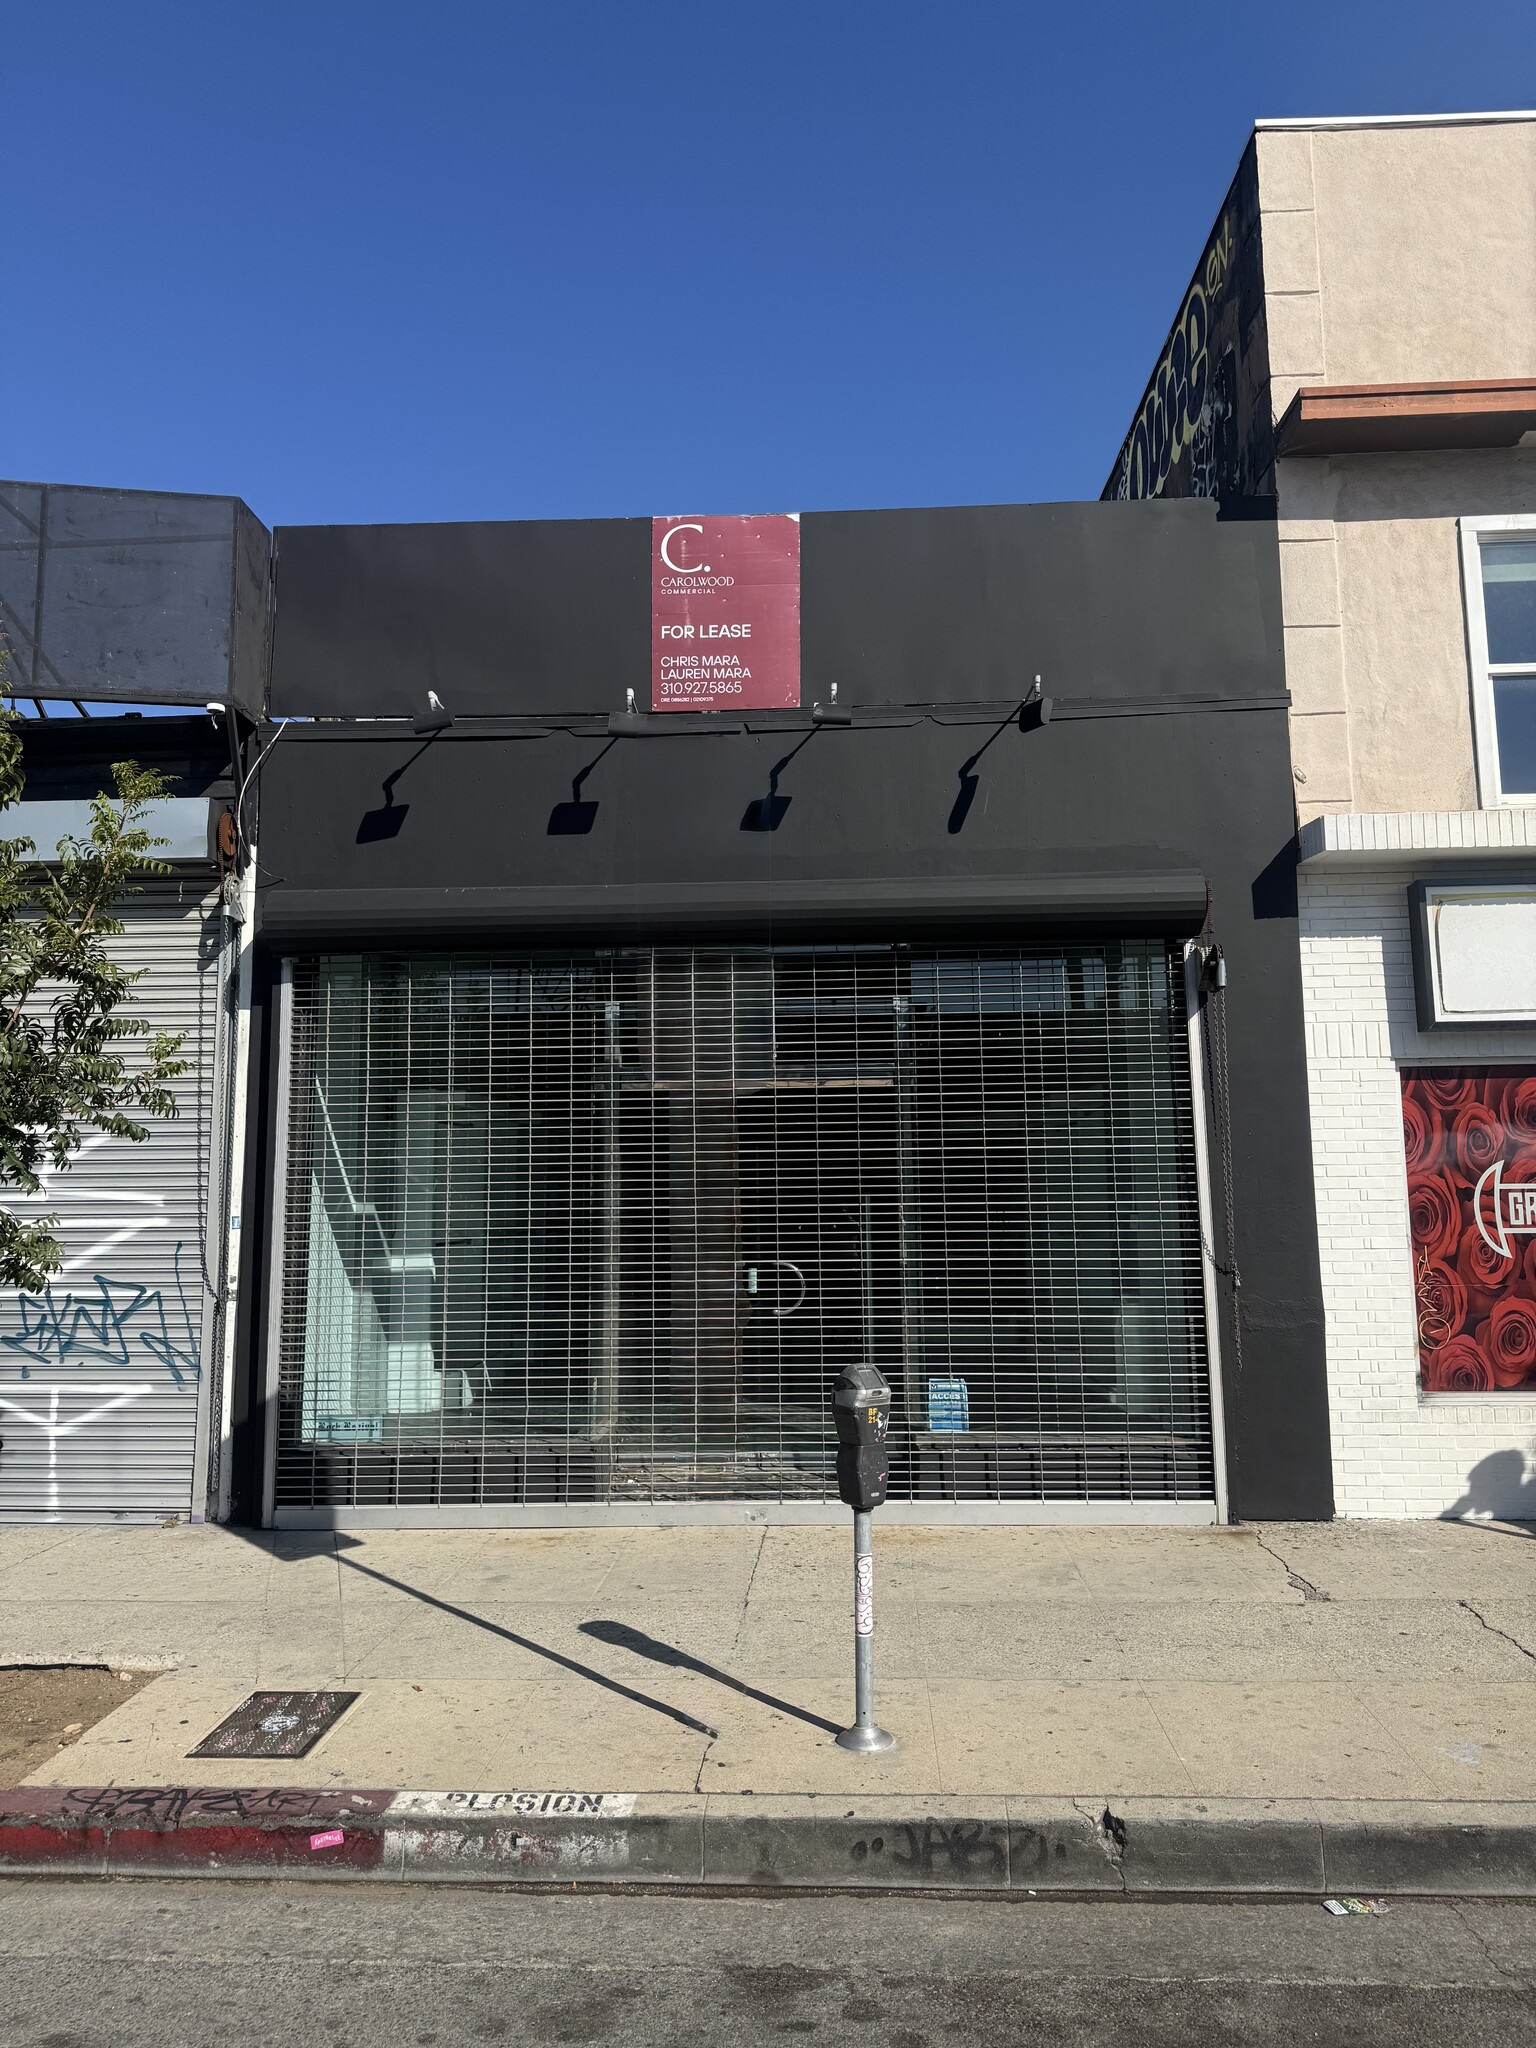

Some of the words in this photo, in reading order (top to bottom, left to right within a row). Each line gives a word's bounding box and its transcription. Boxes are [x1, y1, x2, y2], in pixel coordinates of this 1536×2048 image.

[660, 576, 735, 588] CAROLWOOD
[661, 625, 695, 639] FOR
[699, 624, 752, 639] LEASE
[660, 656, 699, 668] CHRIS
[702, 655, 740, 667] MARA
[660, 668, 710, 680] LAUREN
[713, 667, 752, 679] MARA
[660, 681, 743, 695] 310.927.5865
